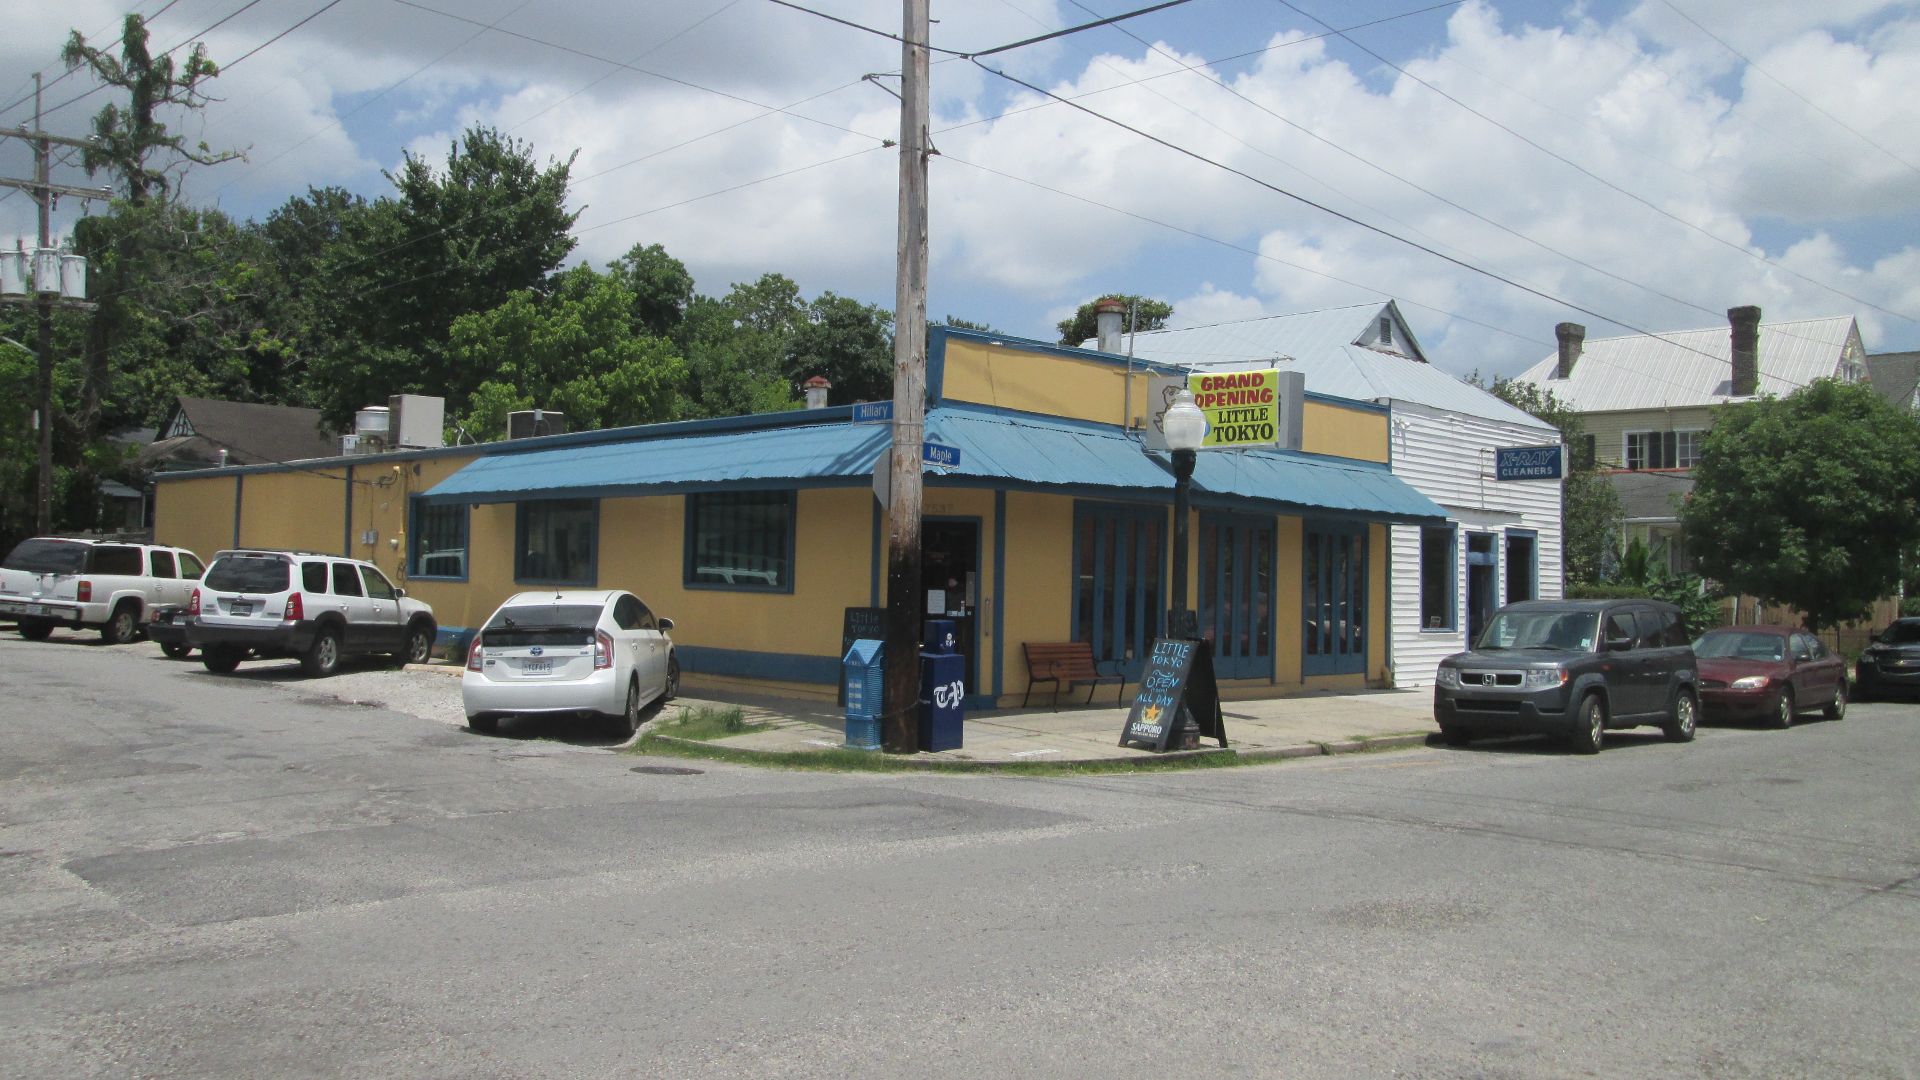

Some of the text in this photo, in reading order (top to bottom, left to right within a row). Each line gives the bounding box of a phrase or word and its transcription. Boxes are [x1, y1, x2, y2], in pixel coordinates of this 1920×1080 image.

[1201, 373, 1264, 391] GRAND
[1195, 388, 1273, 408] OPENING
[861, 405, 888, 418] Hillary
[1218, 408, 1268, 424] LITTLE
[1214, 423, 1273, 442] TOKYO
[930, 446, 952, 463] Maple
[1500, 450, 1556, 467] X-RAY
[1502, 467, 1553, 476] CLEANERS
[1154, 642, 1190, 659] LITTLE
[1151, 655, 1182, 668] TOKYO
[1146, 677, 1179, 688] OPEN
[1137, 693, 1173, 707] ALL DAY
[1131, 722, 1162, 735] SAPPORO
